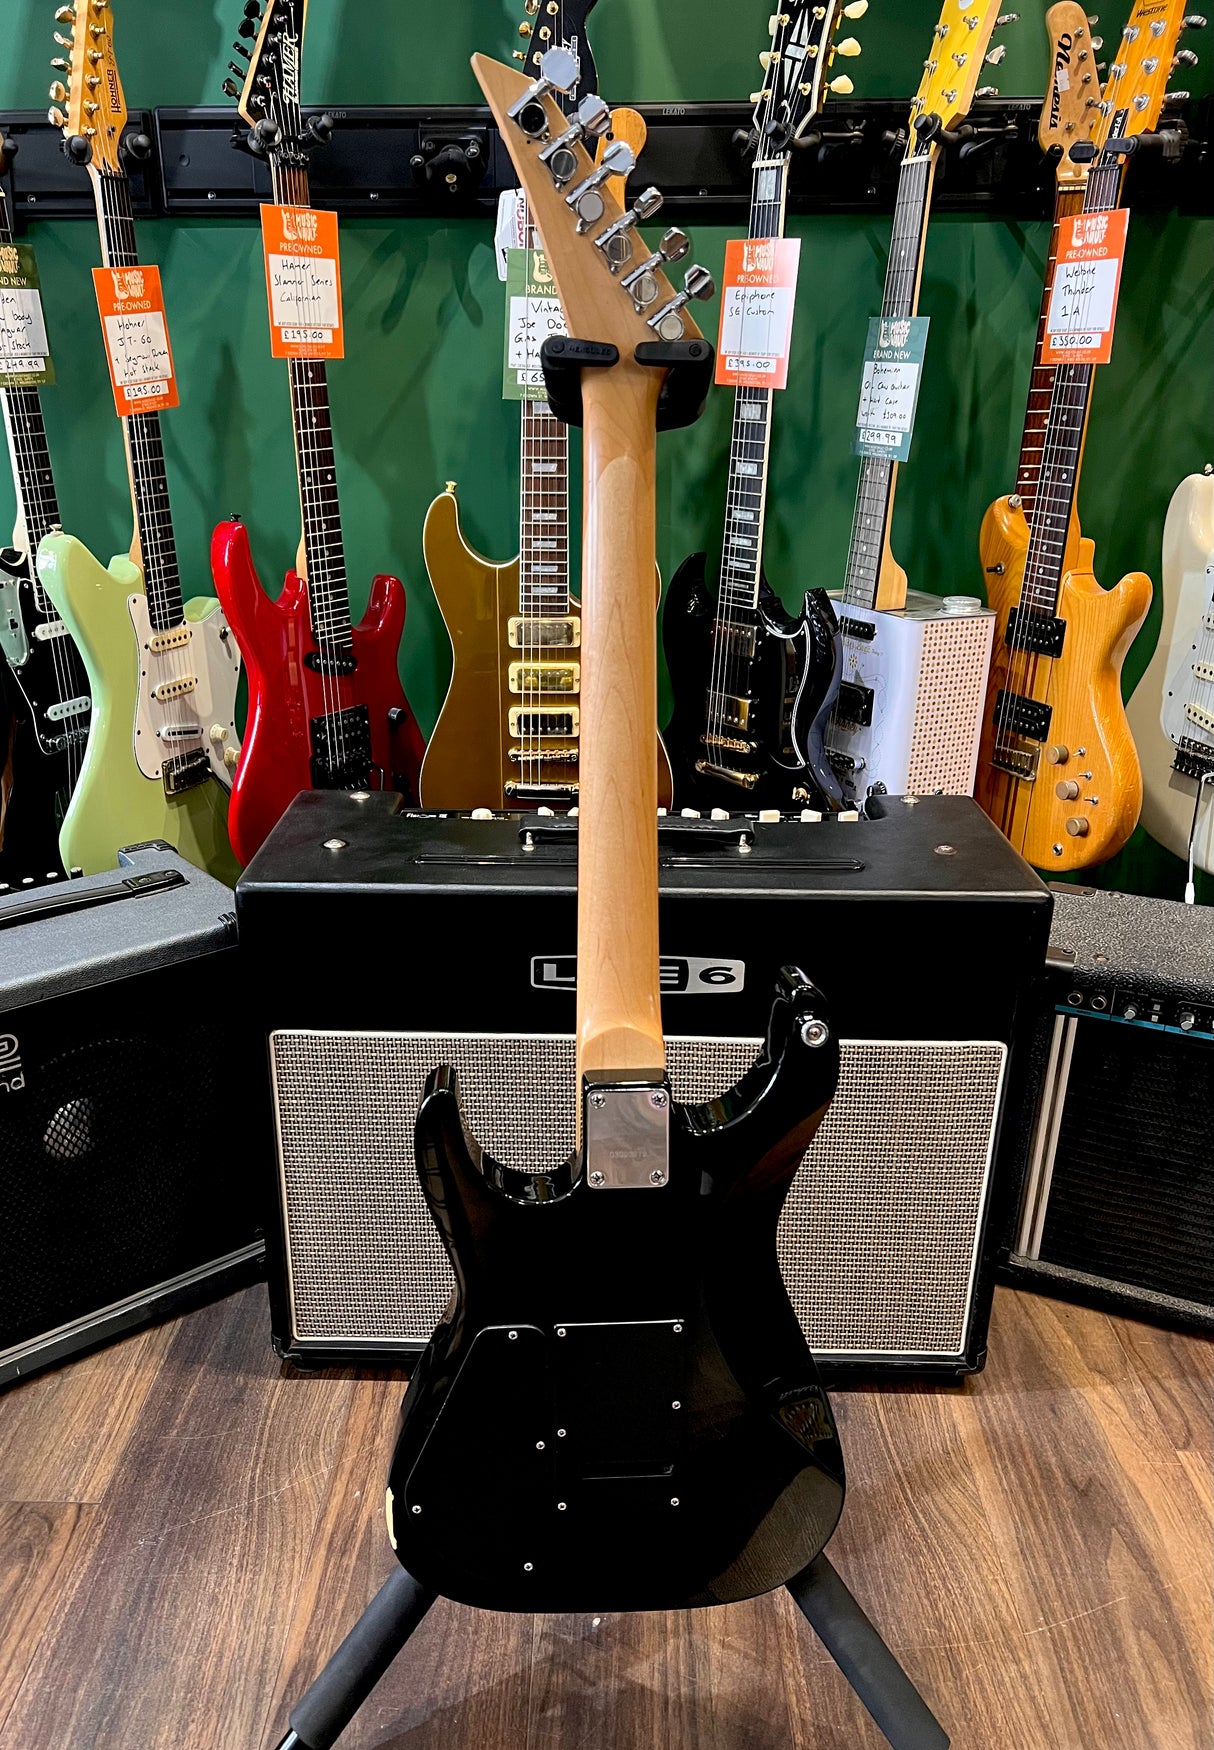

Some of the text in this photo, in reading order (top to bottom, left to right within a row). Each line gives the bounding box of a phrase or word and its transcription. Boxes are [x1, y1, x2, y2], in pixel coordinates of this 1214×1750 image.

[282, 33, 299, 104] HAMER
[1049, 33, 1072, 130] Neesis
[106, 69, 121, 113] HOHNER
[296, 212, 318, 228] MUSIC
[10, 276, 27, 286] NEW
[526, 285, 557, 295] BRAND
[735, 289, 775, 304] Epiphone
[113, 300, 151, 312] PRE-OWNED
[746, 304, 775, 316] Custom
[518, 317, 535, 329] Joe
[873, 350, 911, 360] BRAND NEW
[728, 358, 770, 369] £395.00
[698, 966, 737, 985] 6
